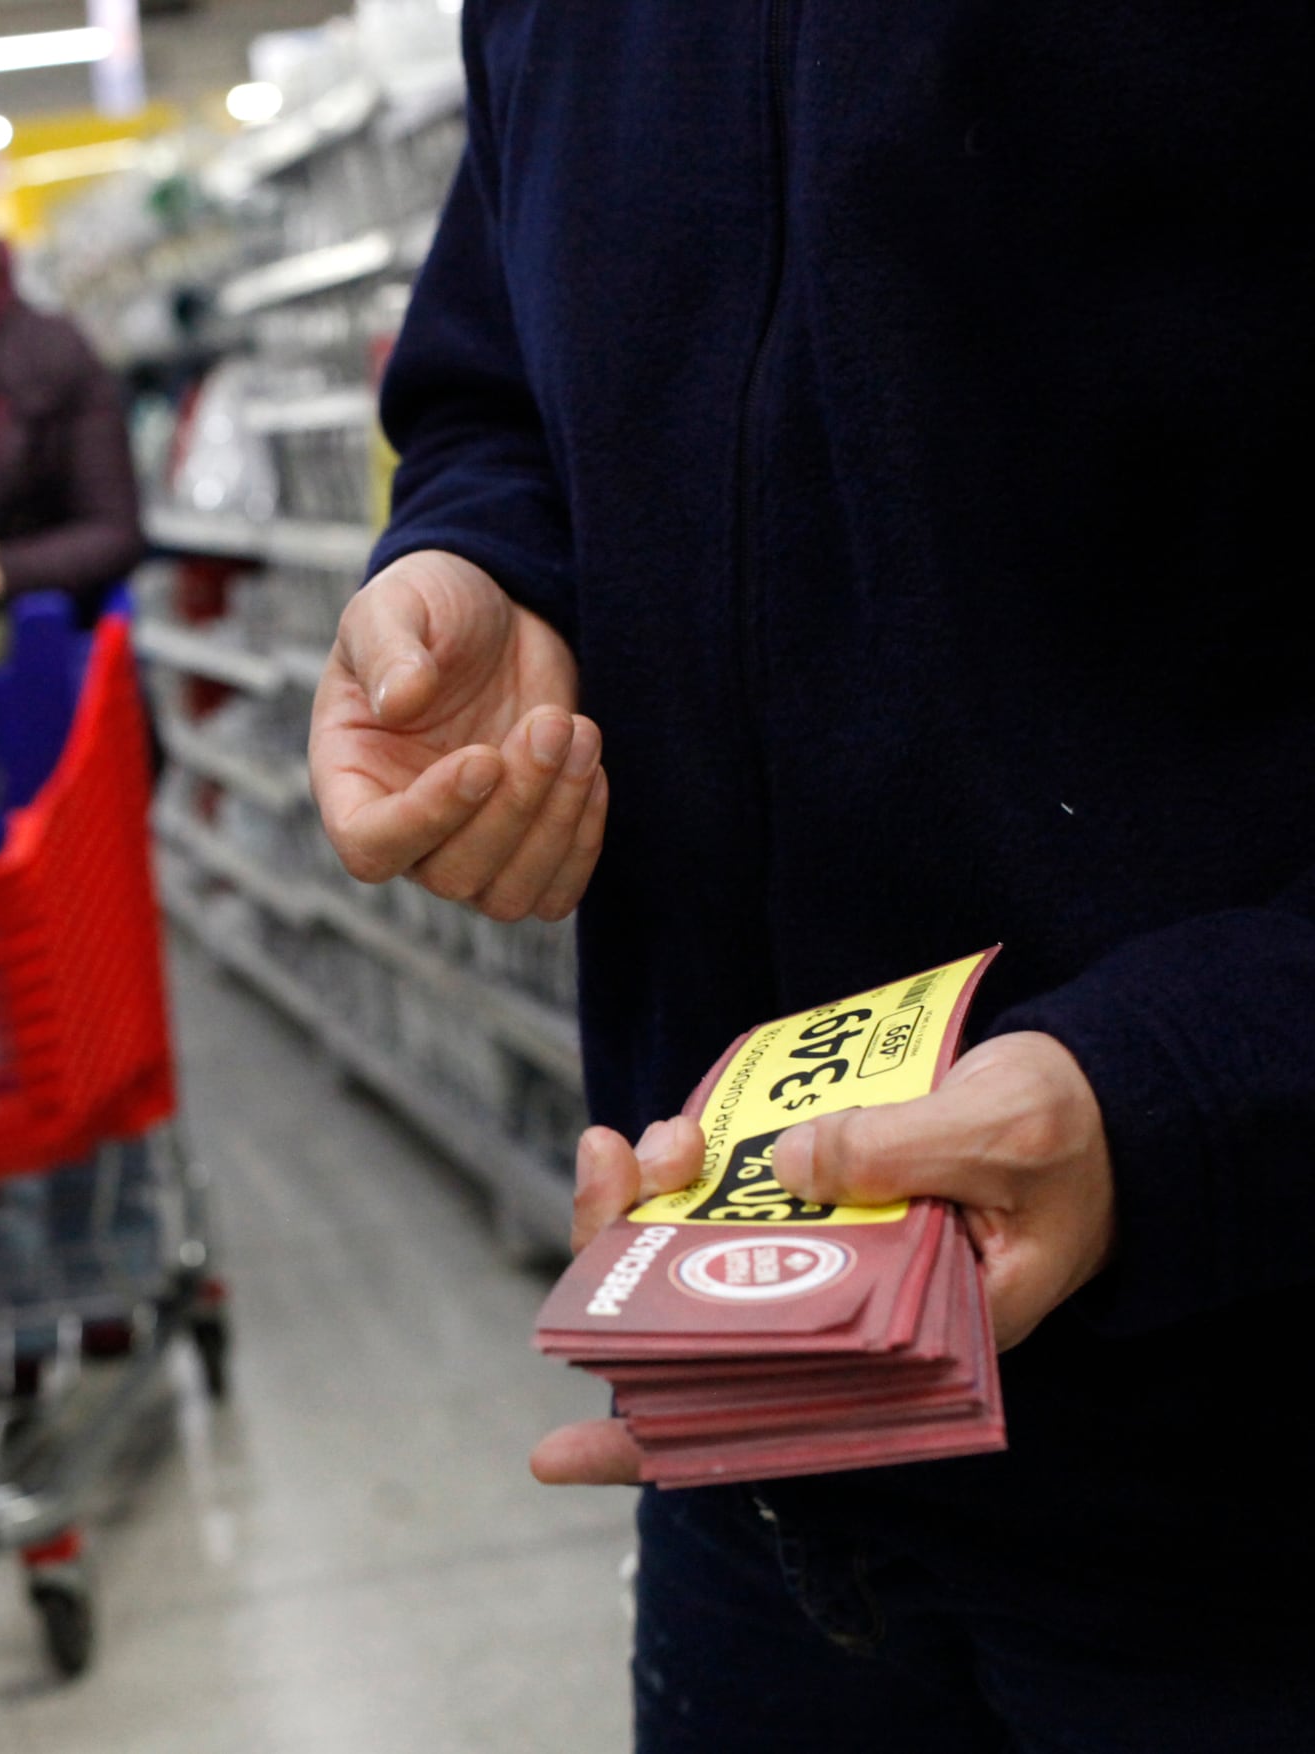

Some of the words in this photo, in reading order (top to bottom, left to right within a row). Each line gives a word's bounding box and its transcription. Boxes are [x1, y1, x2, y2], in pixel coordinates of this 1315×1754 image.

[705, 1113, 731, 1149] STAR
[721, 1043, 770, 1111] CUADRADO
[707, 1144, 792, 1219] 30%
[586, 1225, 678, 1316] PRECIAZO
